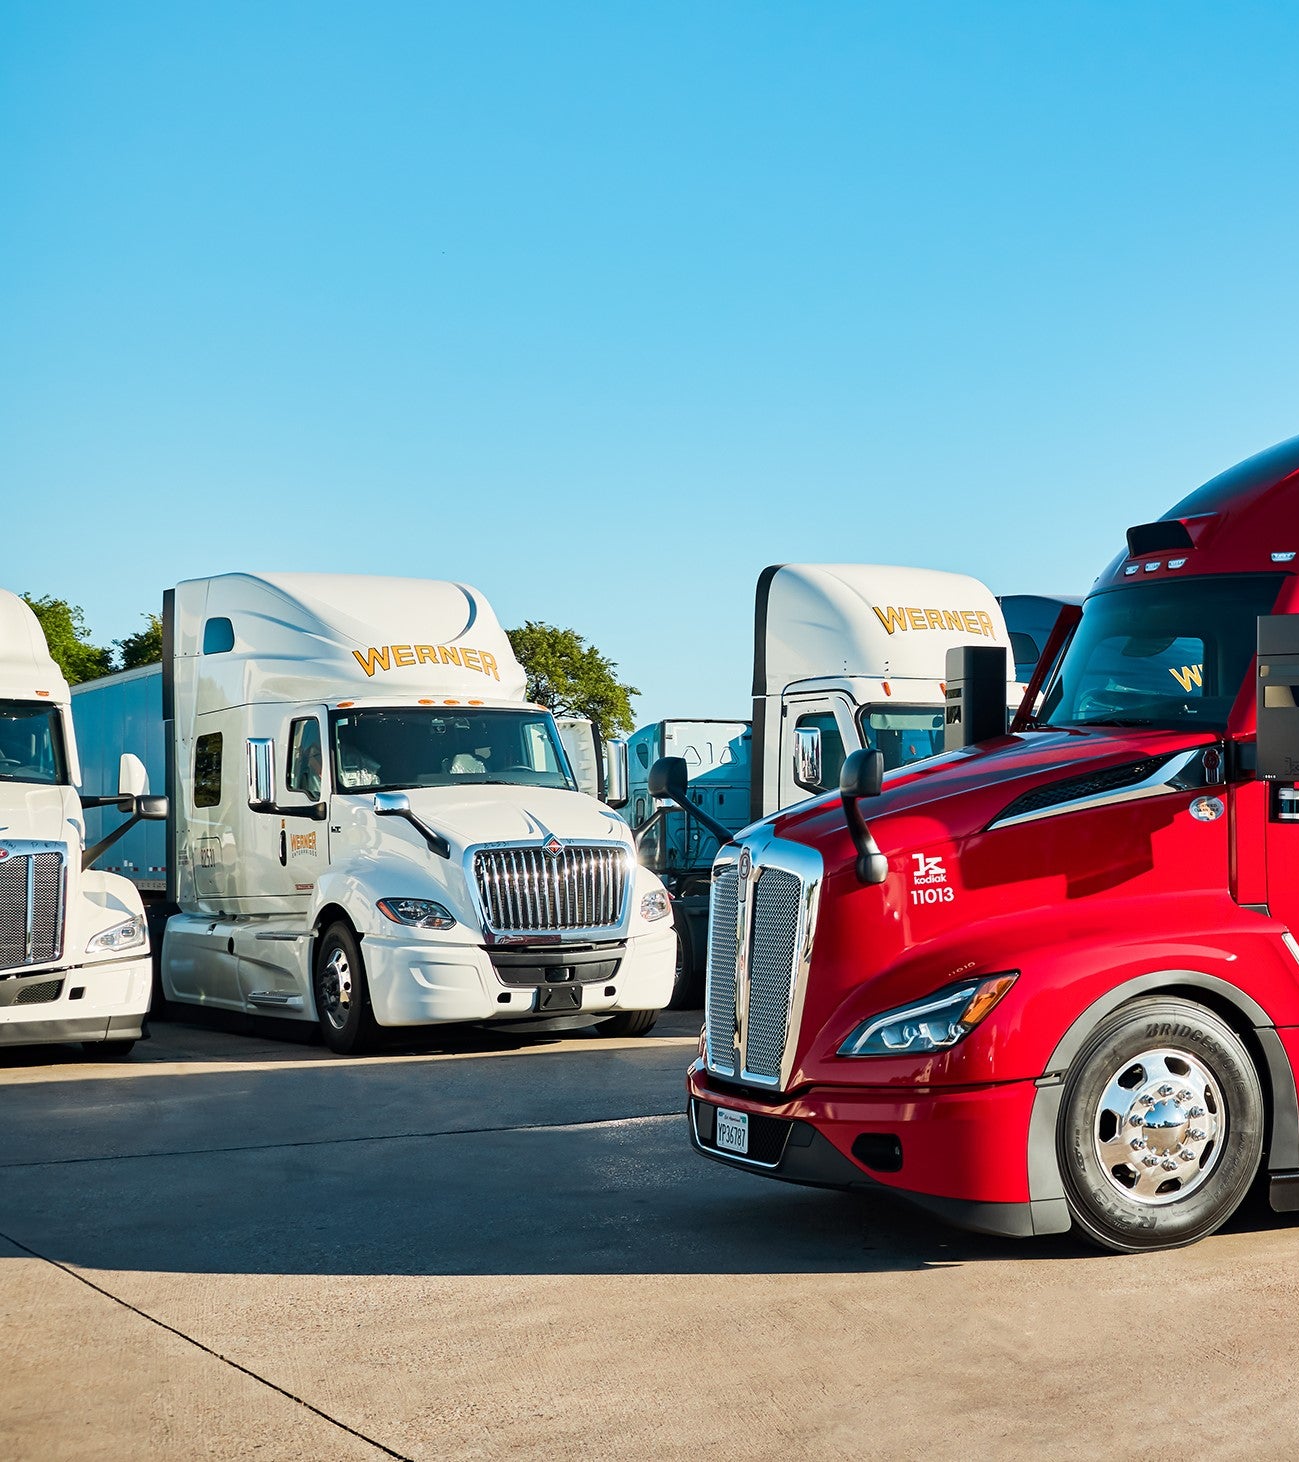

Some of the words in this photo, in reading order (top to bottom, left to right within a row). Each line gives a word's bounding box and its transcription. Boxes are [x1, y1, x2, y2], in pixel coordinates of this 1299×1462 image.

[872, 606, 997, 641] WERNER
[352, 644, 500, 682] WERNER
[1169, 664, 1203, 692] W
[914, 874, 947, 885] kodiak
[911, 887, 954, 905] 11013
[1145, 1023, 1246, 1094] BRIDGESTONE
